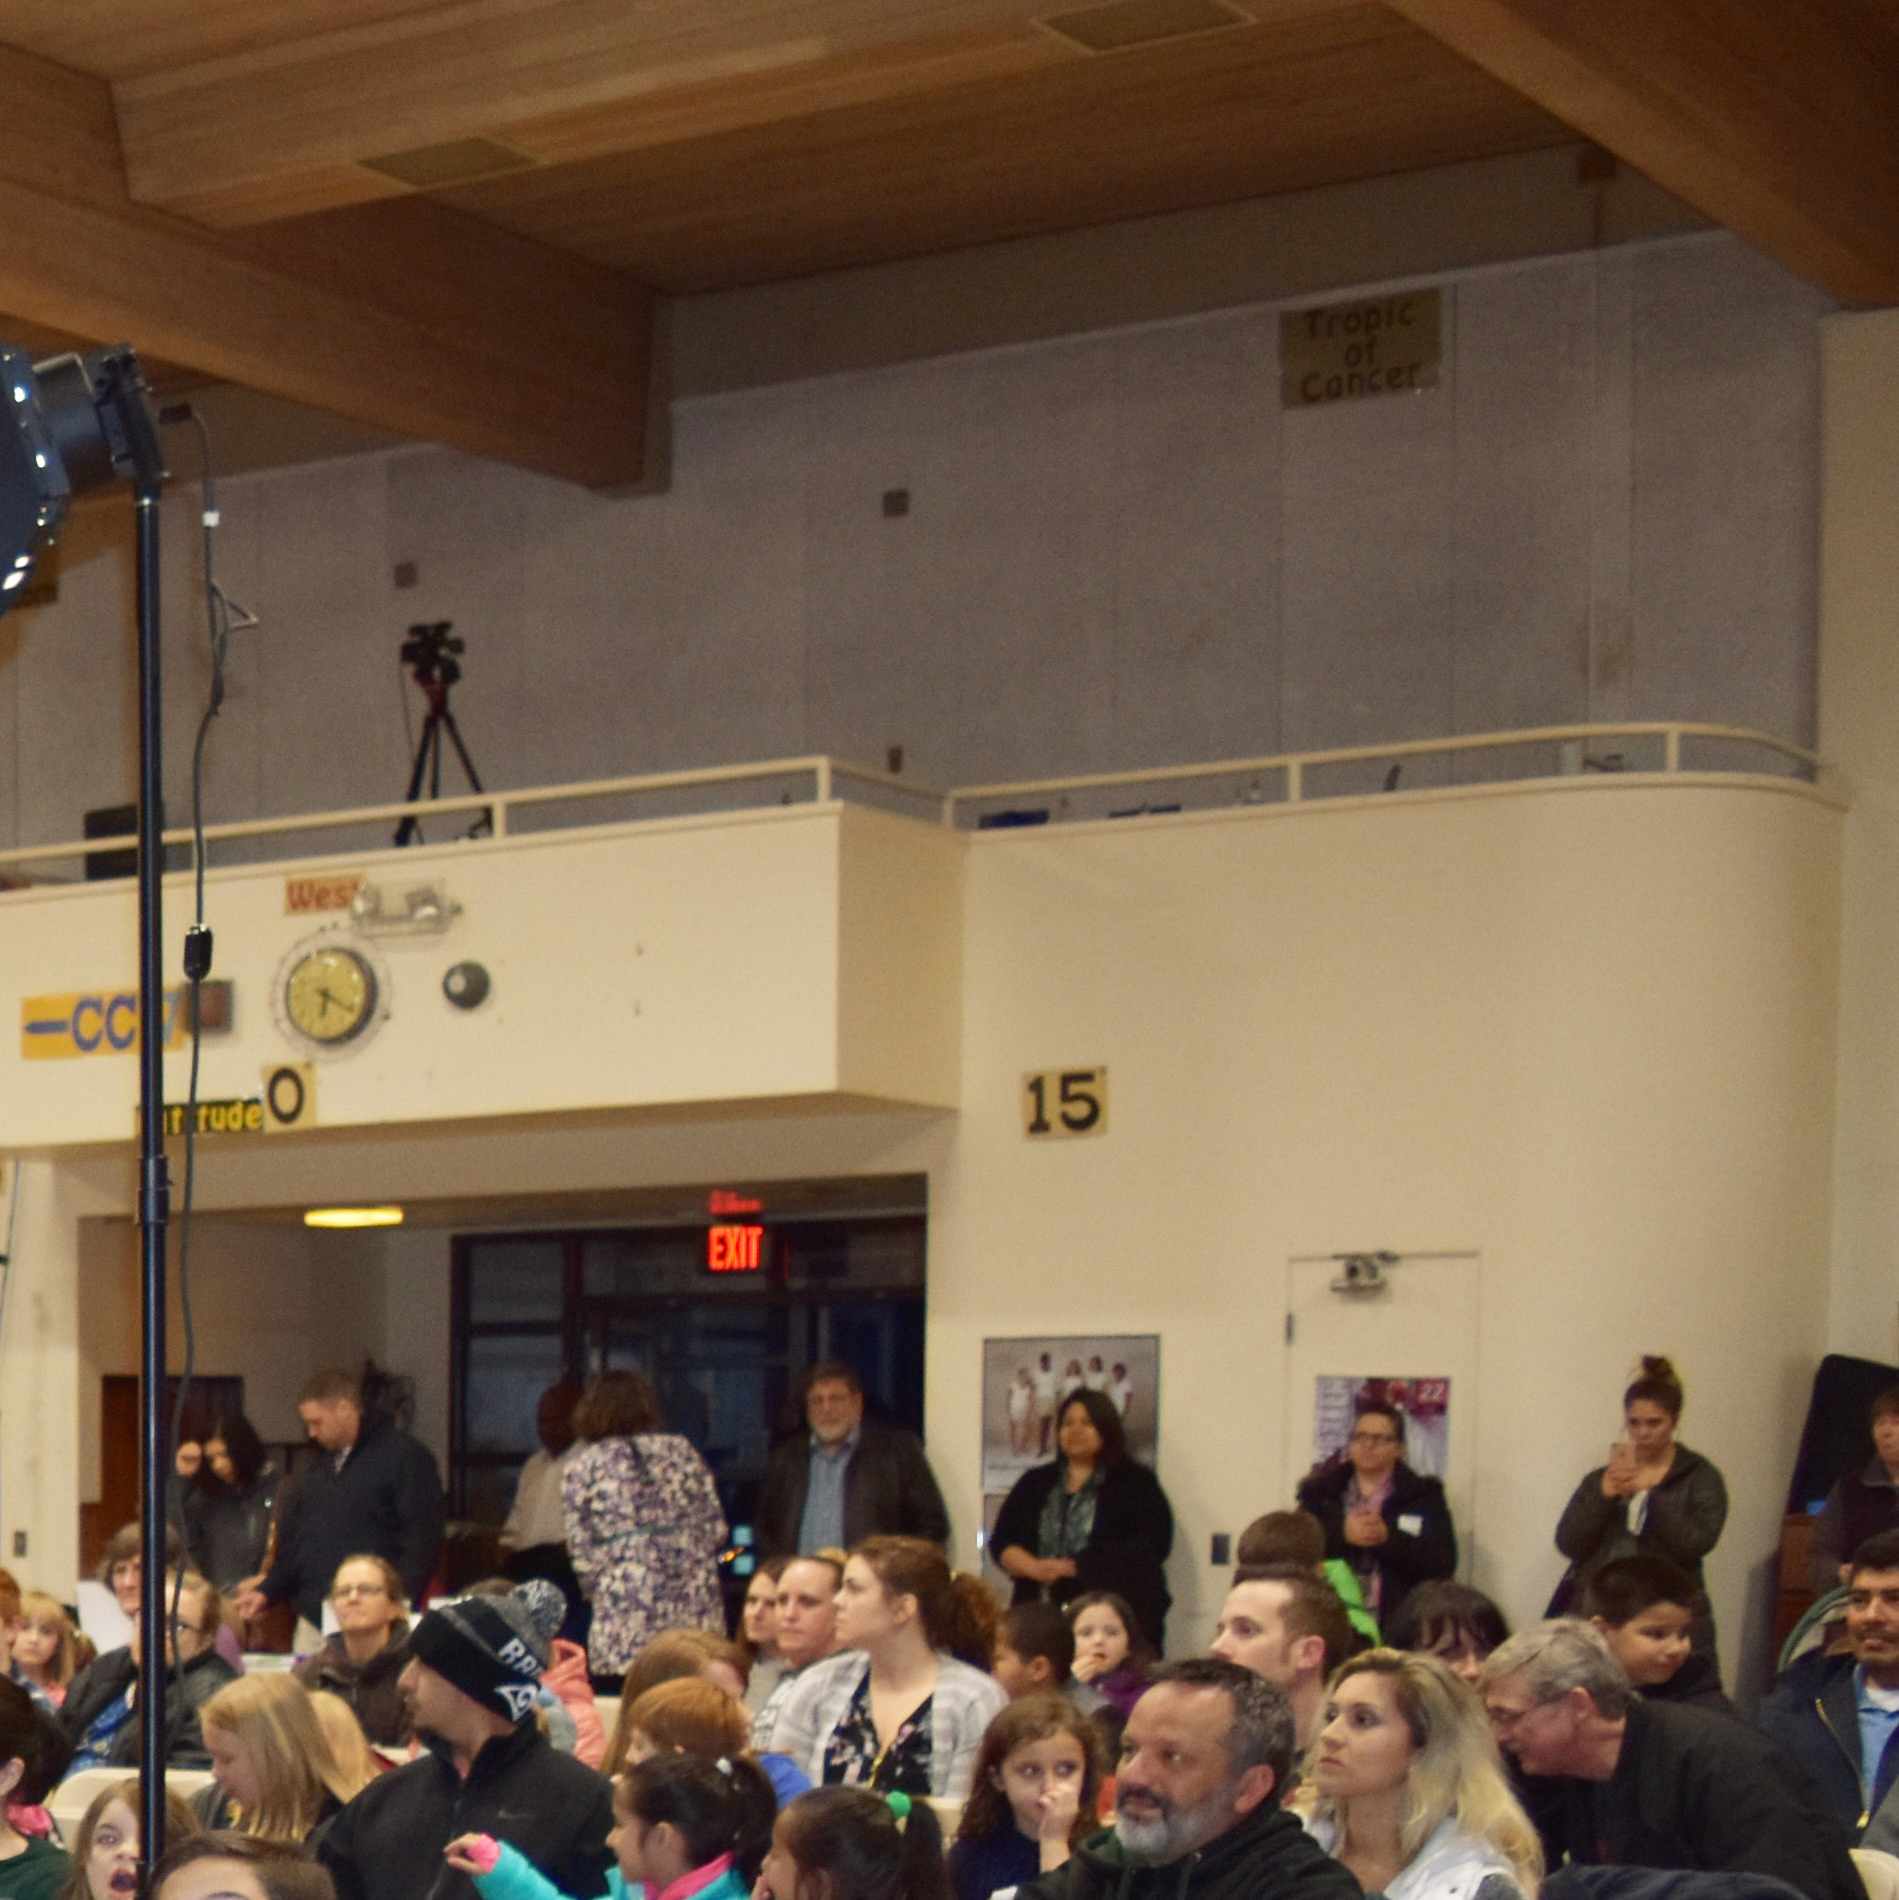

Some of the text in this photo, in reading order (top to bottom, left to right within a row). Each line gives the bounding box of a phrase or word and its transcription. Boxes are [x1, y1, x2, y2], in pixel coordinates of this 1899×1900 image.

[1303, 300, 1417, 339] Tropic
[1343, 336, 1377, 367] of
[1301, 361, 1423, 403] Cancer
[1028, 1072, 1100, 1133] 15
[709, 1226, 763, 1270] EXIT
